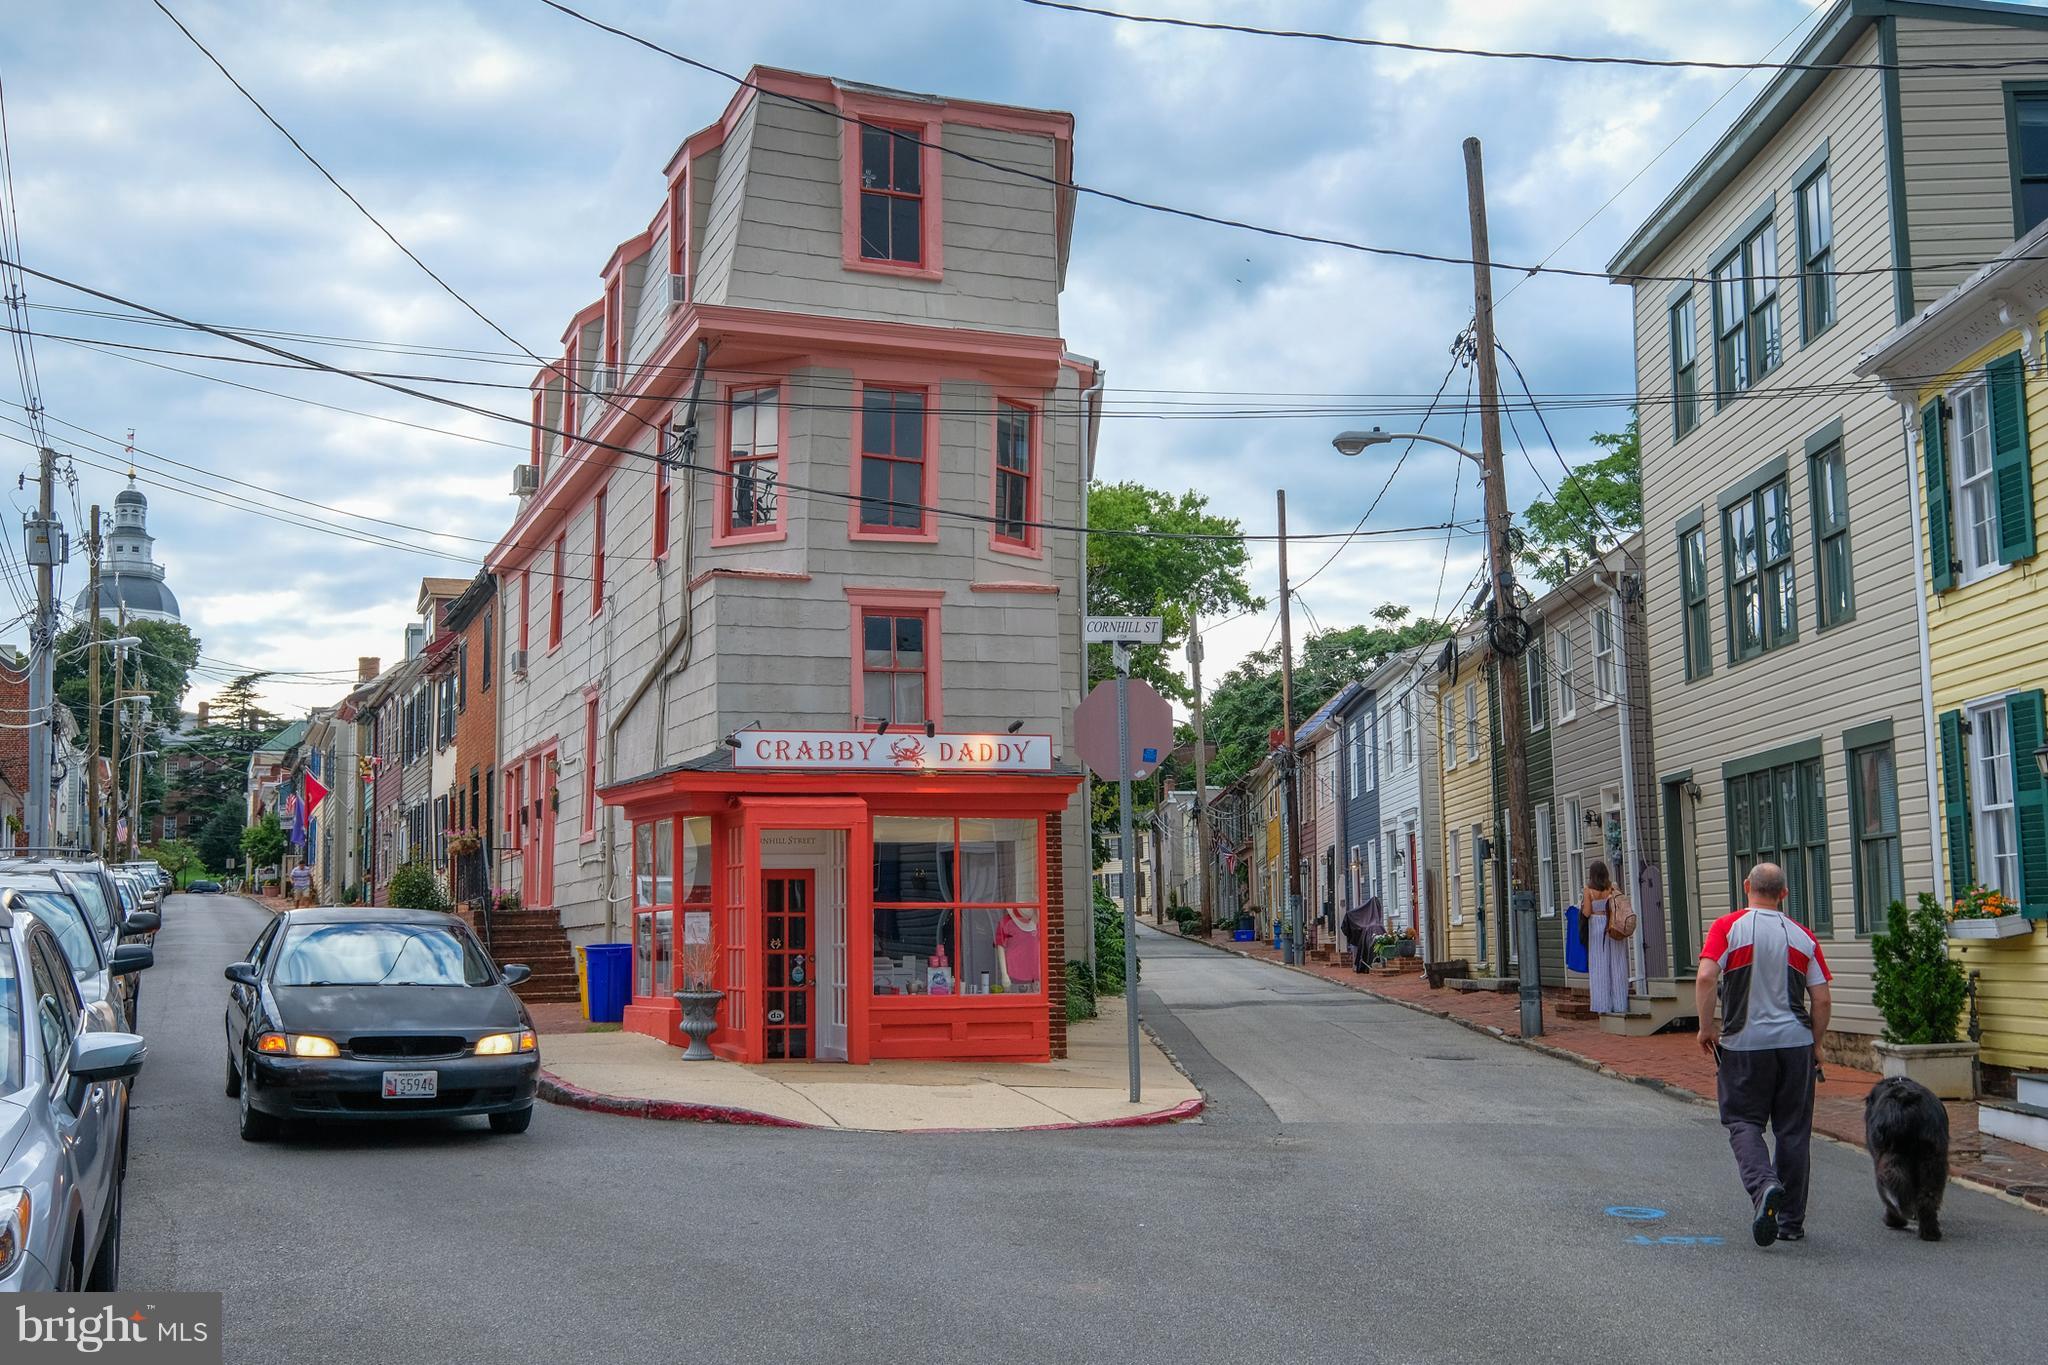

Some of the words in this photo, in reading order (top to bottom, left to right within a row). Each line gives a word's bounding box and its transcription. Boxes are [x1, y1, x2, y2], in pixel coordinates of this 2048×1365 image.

[1086, 621, 1141, 633] CORNHILL
[1143, 621, 1159, 633] ST
[756, 737, 877, 761] CRABBY
[939, 740, 1031, 763] DADDY
